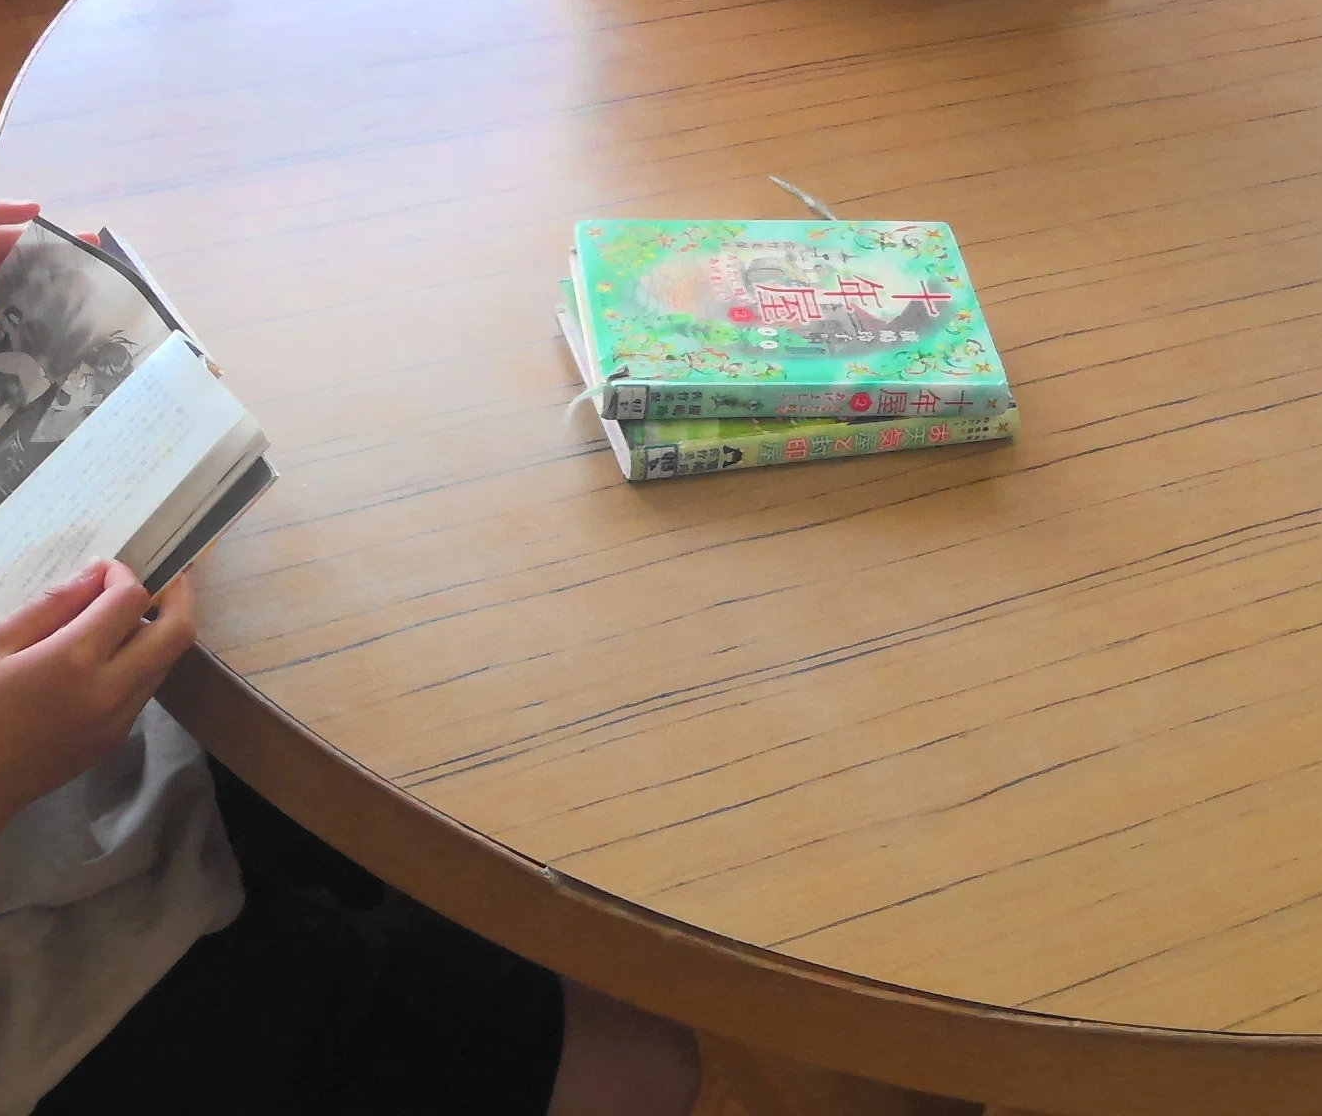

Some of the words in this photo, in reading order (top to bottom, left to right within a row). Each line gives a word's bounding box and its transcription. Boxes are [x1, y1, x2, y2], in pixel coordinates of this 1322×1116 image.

[755, 273, 953, 325] 十年屋
[877, 387, 975, 415] 十年屋
[760, 423, 953, 461] お天気屋と封印屋
